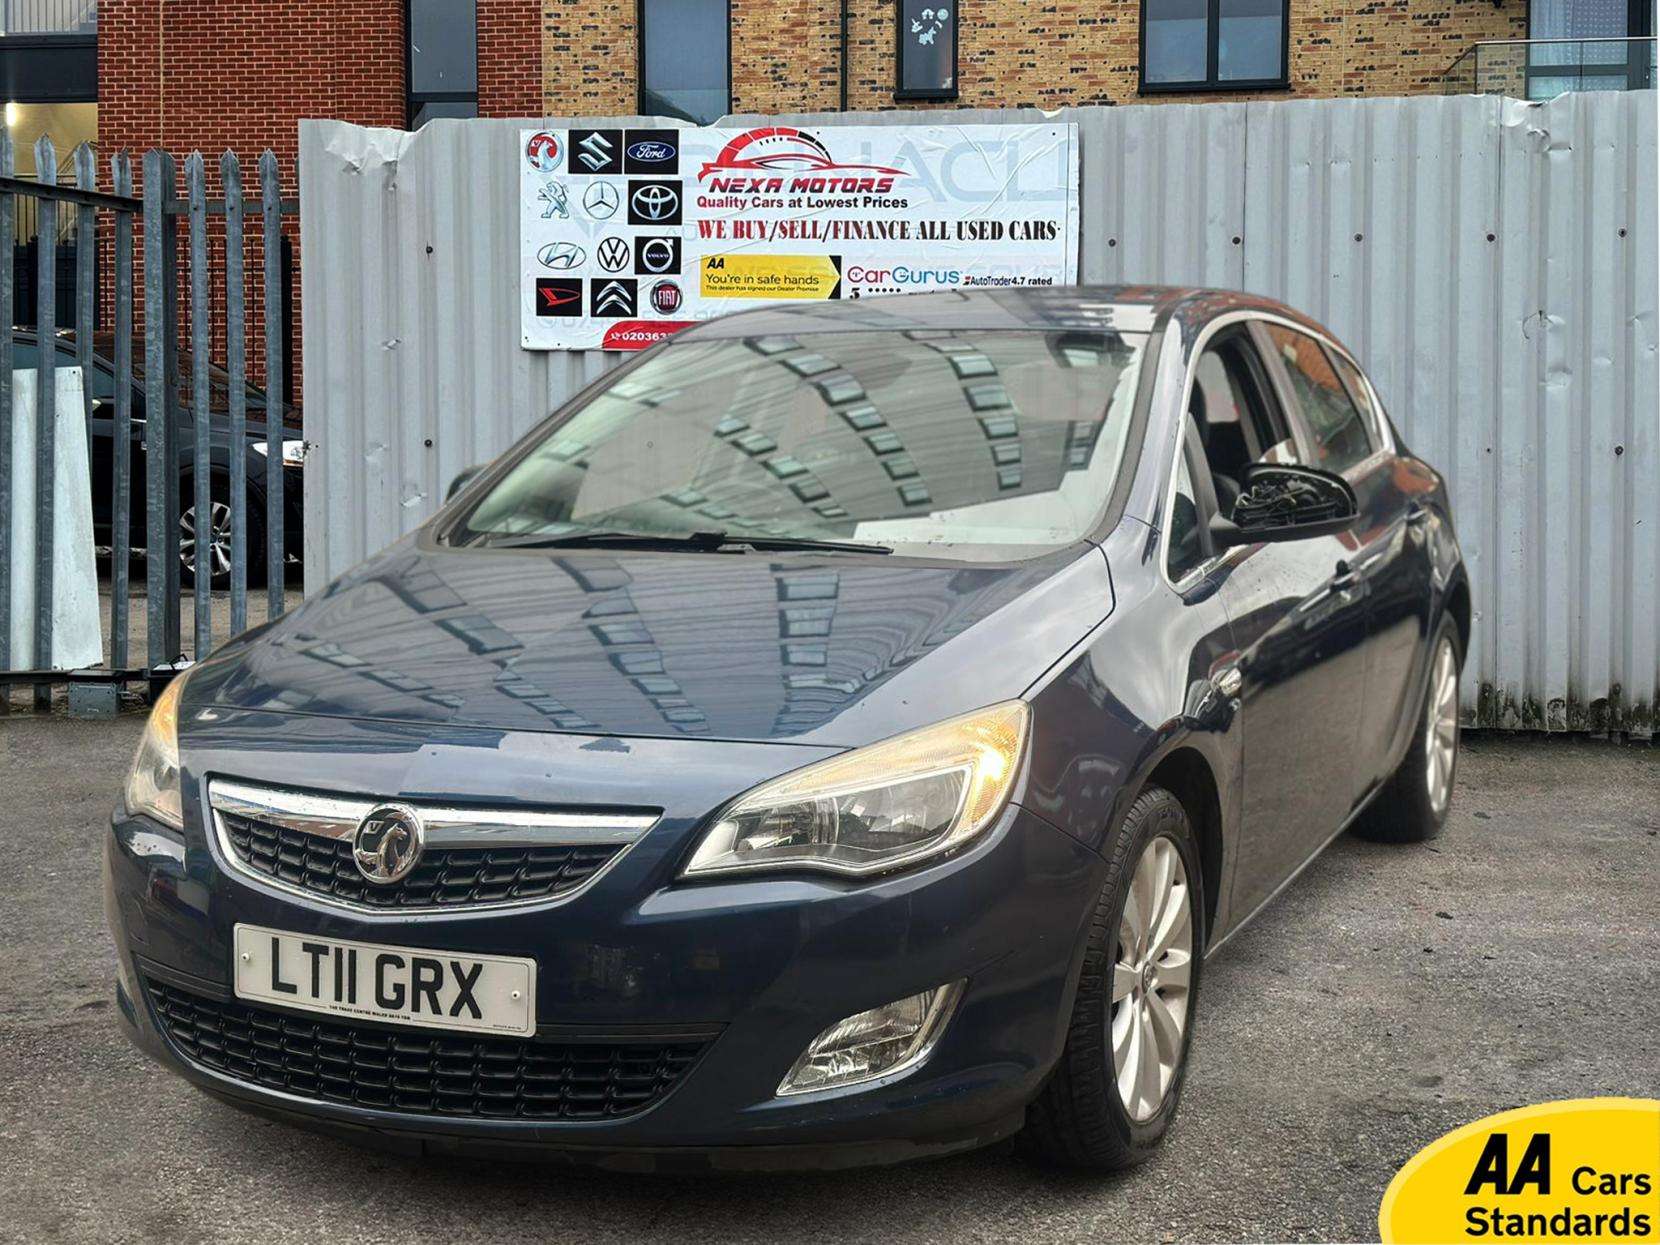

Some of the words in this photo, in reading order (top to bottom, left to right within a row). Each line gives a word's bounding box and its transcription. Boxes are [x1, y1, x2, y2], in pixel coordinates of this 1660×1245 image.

[636, 144, 665, 158] Ford
[709, 178, 783, 193] NEXA
[789, 178, 894, 194] MOTORS
[697, 196, 747, 209] Quality
[752, 196, 784, 208] Cars
[788, 197, 803, 208] at
[807, 196, 859, 208] Lowest
[863, 196, 908, 208] Prices
[697, 220, 727, 239] WE
[916, 220, 950, 240] ALL
[956, 220, 1004, 240] USED
[1009, 220, 1057, 241] CARS
[707, 258, 725, 269] AA
[706, 274, 741, 284] You're
[744, 273, 754, 284] in
[757, 273, 780, 284] safe
[784, 274, 819, 285] hands
[847, 265, 960, 284] CarGurus
[1028, 277, 1052, 285] rated
[658, 290, 676, 305] FIAT
[271, 937, 357, 1004] LT11
[374, 953, 483, 1019] GRX
